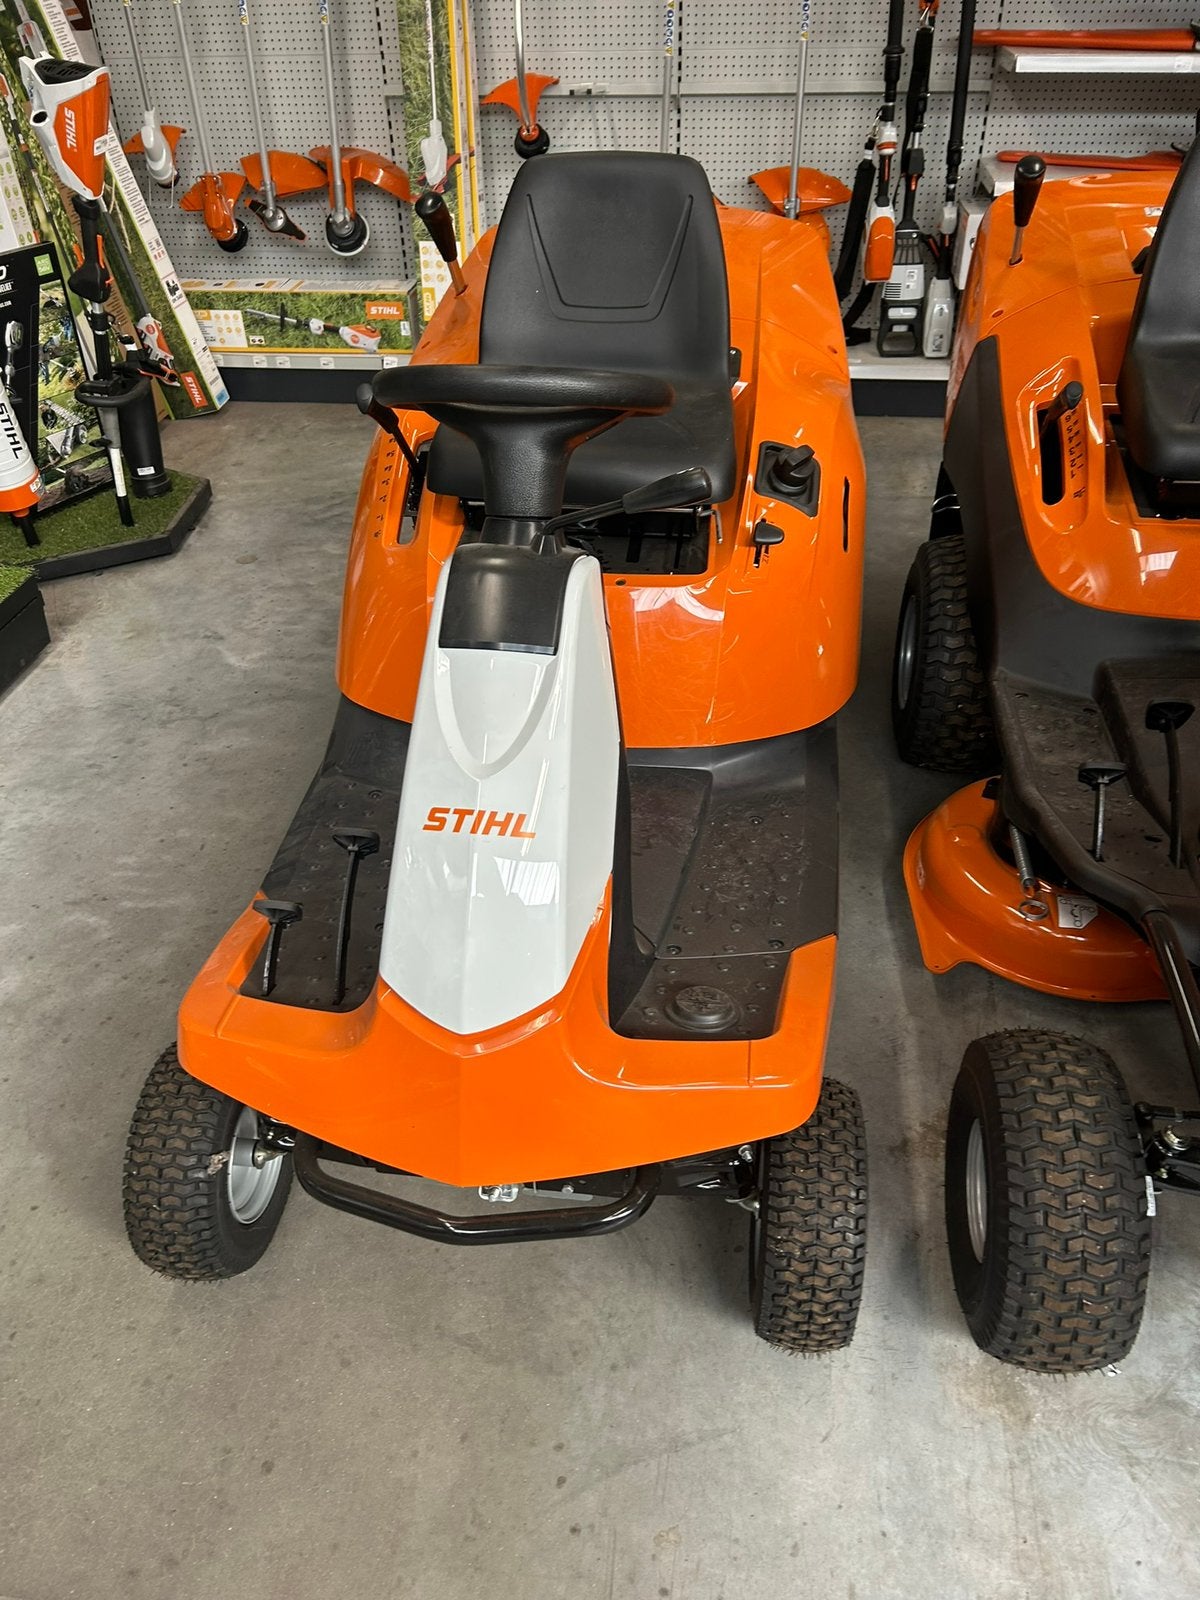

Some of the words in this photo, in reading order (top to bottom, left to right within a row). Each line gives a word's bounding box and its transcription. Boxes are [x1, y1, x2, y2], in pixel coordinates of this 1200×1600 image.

[64, 107, 77, 149] STIHL
[370, 305, 400, 315] STIHL
[184, 376, 202, 404] STIHL
[0, 402, 23, 459] STIHL
[422, 806, 537, 839] STIHL
